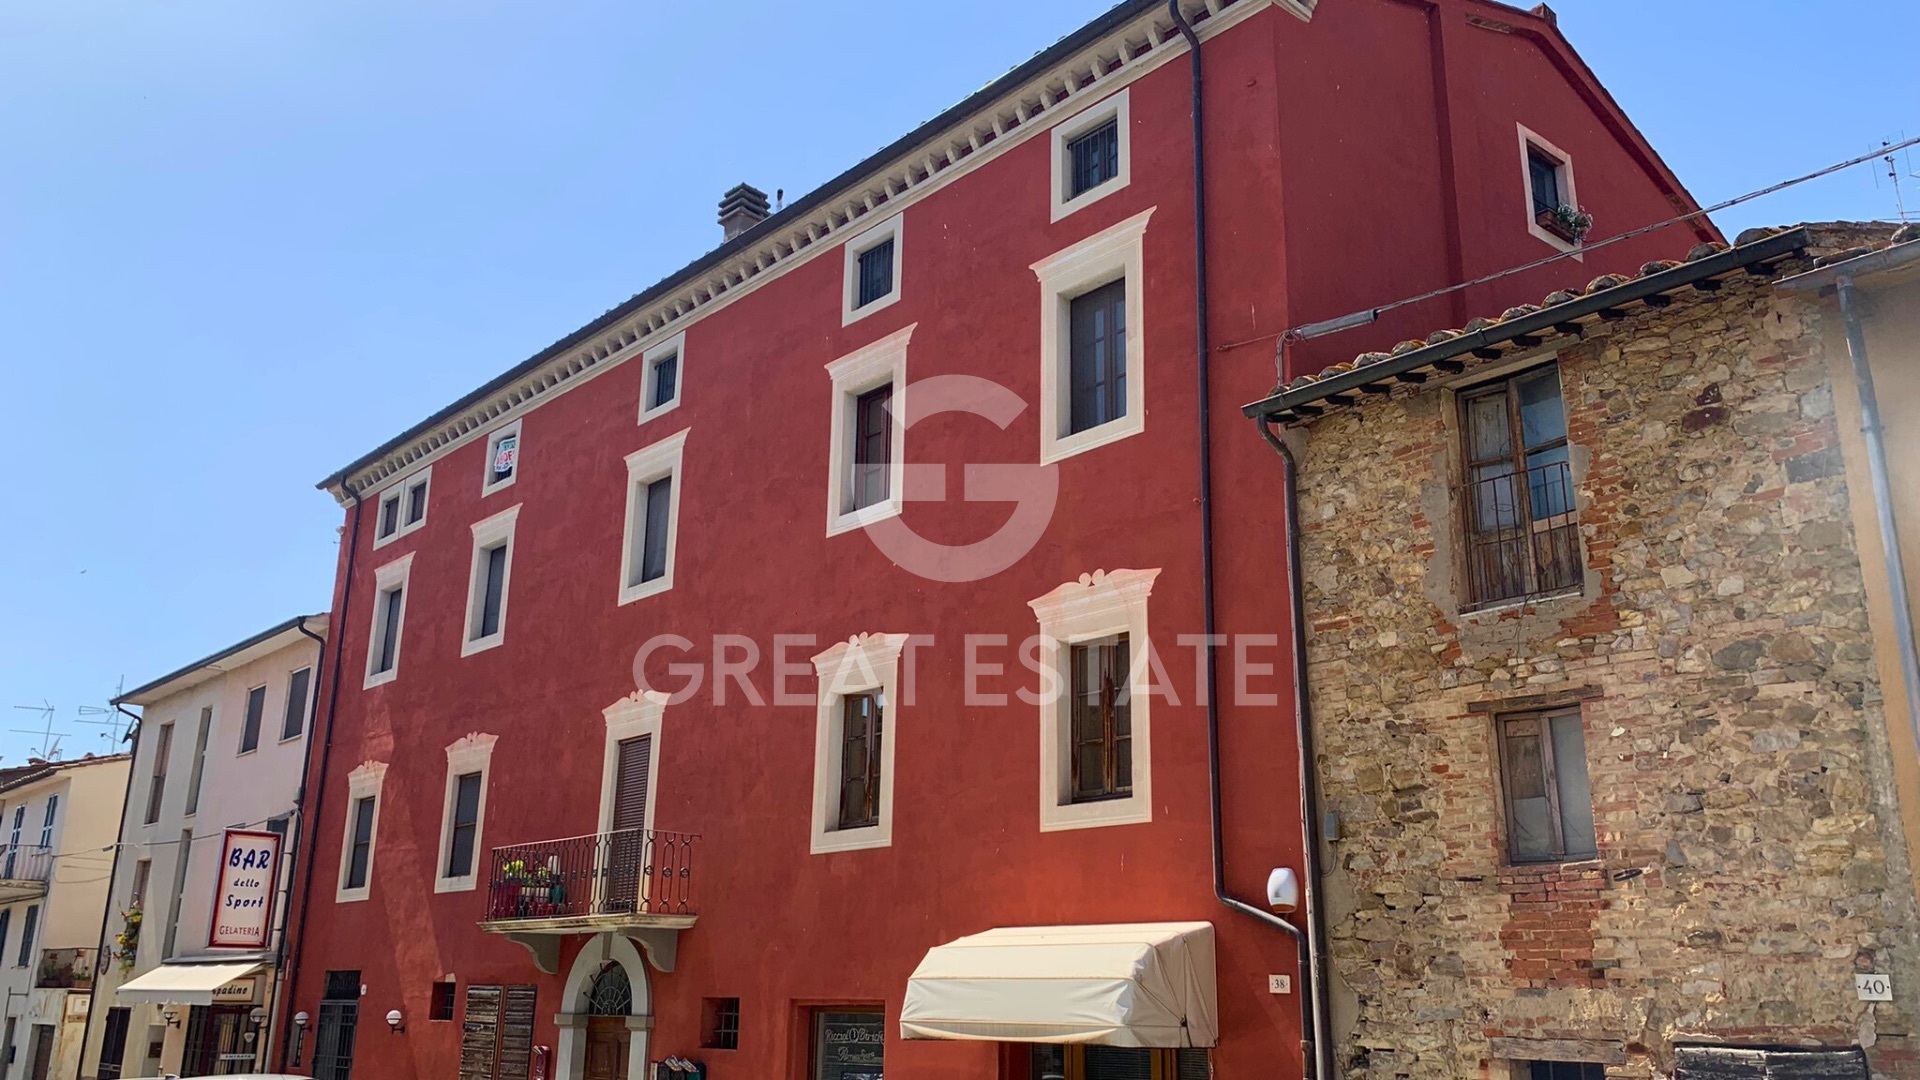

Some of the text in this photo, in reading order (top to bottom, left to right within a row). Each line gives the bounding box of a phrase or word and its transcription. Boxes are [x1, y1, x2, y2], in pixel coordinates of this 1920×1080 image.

[229, 847, 271, 870] BAR
[233, 878, 260, 888] dello
[226, 894, 264, 910] Sport
[219, 925, 260, 936] GELATERIA
[1862, 979, 1885, 995] 40
